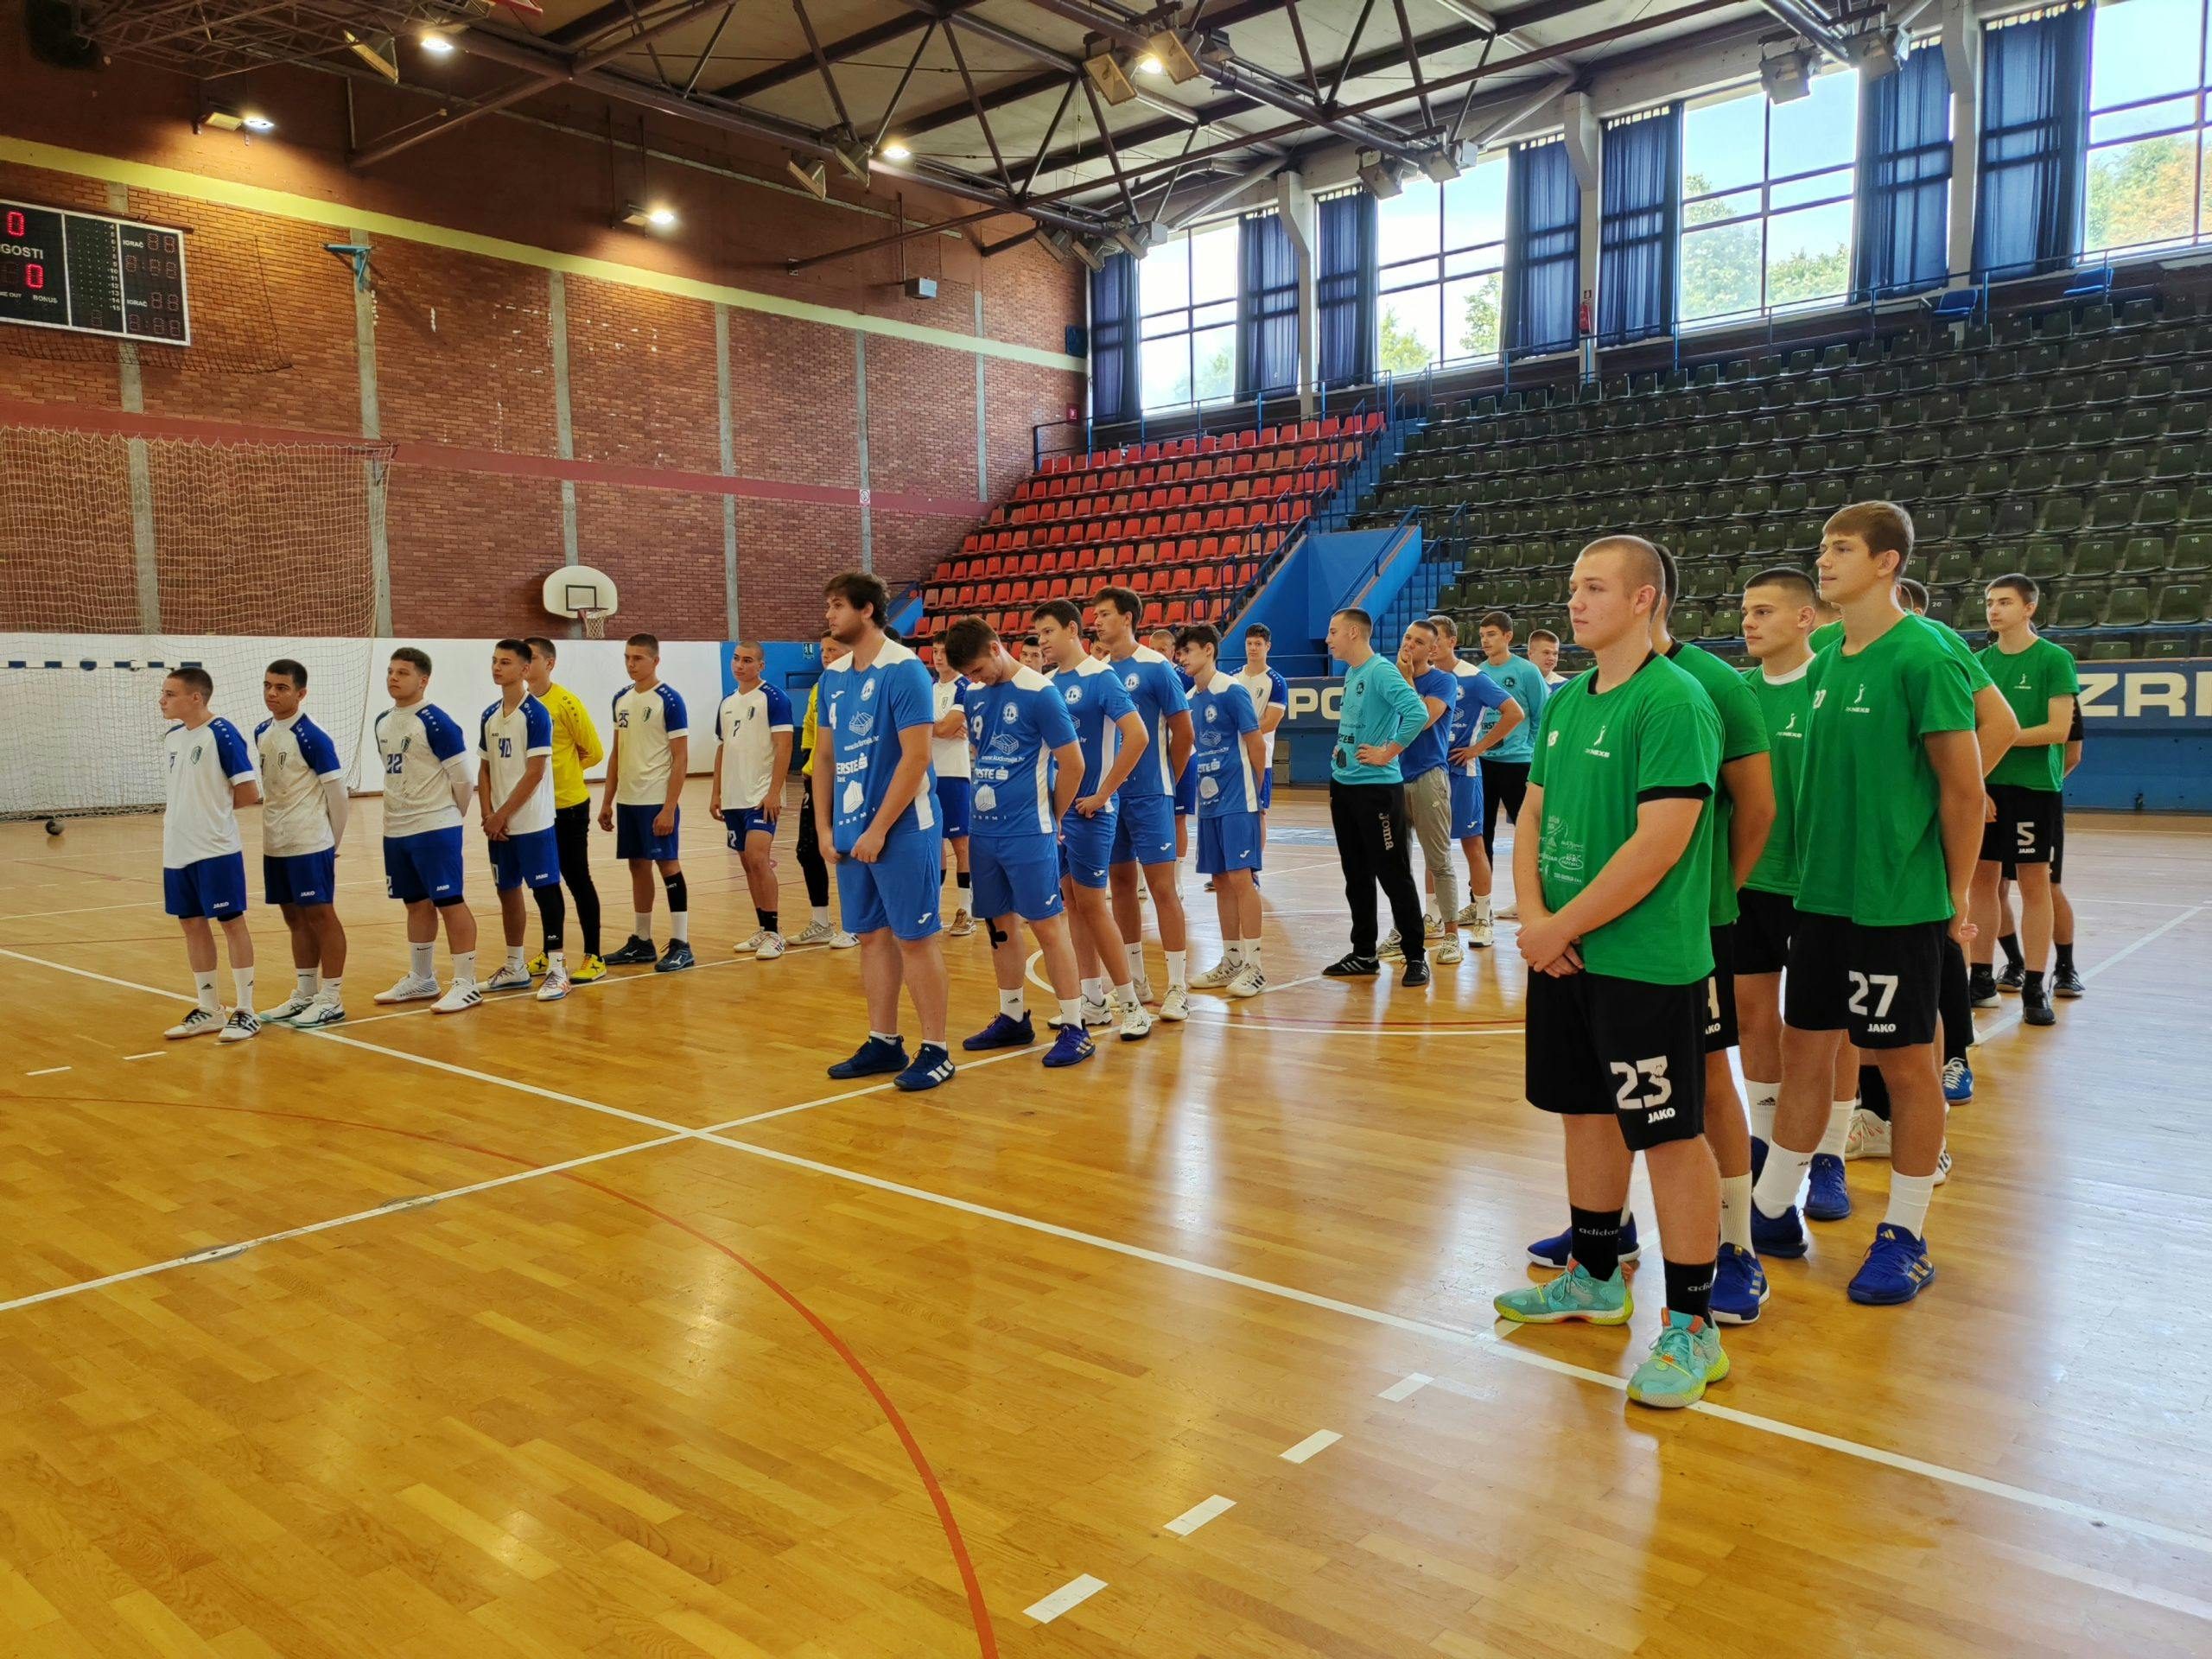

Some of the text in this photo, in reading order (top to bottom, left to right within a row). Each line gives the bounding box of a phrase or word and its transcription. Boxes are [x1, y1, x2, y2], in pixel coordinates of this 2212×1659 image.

[7, 211, 25, 237] 0
[0, 244, 43, 259] GOSTI
[26, 263, 44, 289] 0
[33, 295, 58, 303] BONUS
[386, 753, 403, 774] 22
[836, 759, 860, 775] ERSTE
[1378, 811, 1395, 851] Joma
[2017, 822, 2035, 846] 5
[1848, 970, 1899, 1018] 27
[1867, 1023, 1897, 1033] JAKO
[1610, 1055, 1672, 1110] 23
[1647, 1107, 1676, 1124] JAKO
